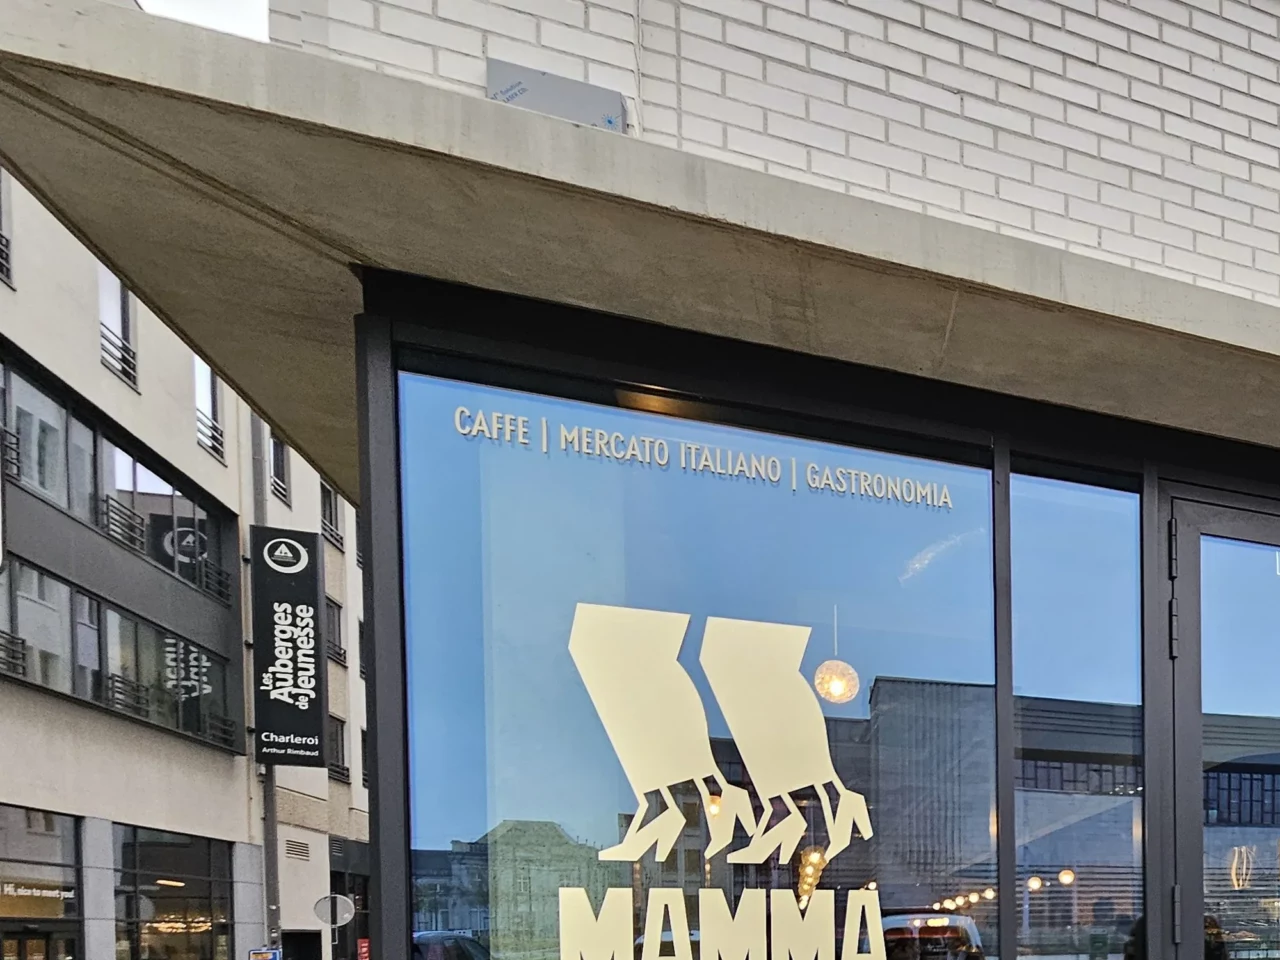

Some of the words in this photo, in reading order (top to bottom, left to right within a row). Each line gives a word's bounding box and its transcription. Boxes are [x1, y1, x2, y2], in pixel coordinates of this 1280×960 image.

[454, 406, 530, 444] CAFFE
[560, 424, 669, 466] MERCATO
[680, 443, 781, 482] ITALIANO
[806, 463, 953, 508] GASTRONOMIA
[268, 602, 297, 704] Auberges
[292, 604, 316, 699] Jeunesse
[260, 673, 273, 690] Les
[295, 695, 309, 710] de
[261, 732, 319, 745] Charleroi
[286, 748, 319, 756] Rimbaud
